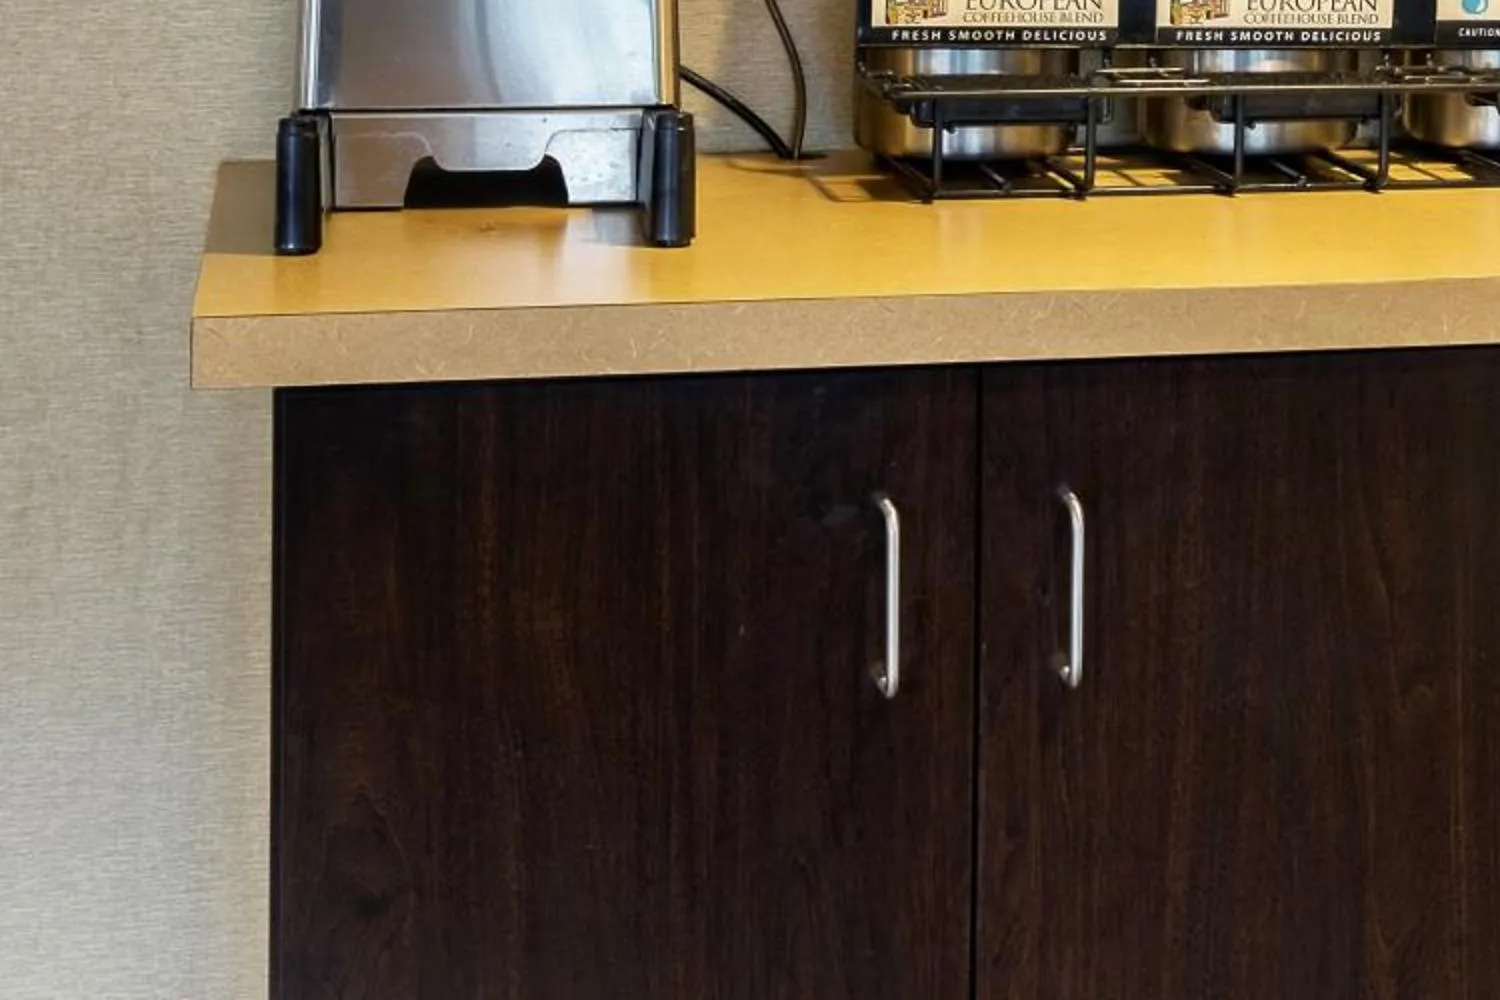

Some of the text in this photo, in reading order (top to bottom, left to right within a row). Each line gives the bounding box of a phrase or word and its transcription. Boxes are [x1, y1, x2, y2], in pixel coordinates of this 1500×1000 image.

[963, 10, 1104, 24] COFFEEHOUSE BLEND
[1243, 11, 1380, 25] COFFEEHOUSE BLEND
[892, 29, 1107, 42] FRESH SMOOTH DELICIOUS
[1175, 30, 1382, 42] FRESH SMOOTH DELICIOUS
[1458, 27, 1500, 38] CAUTION
